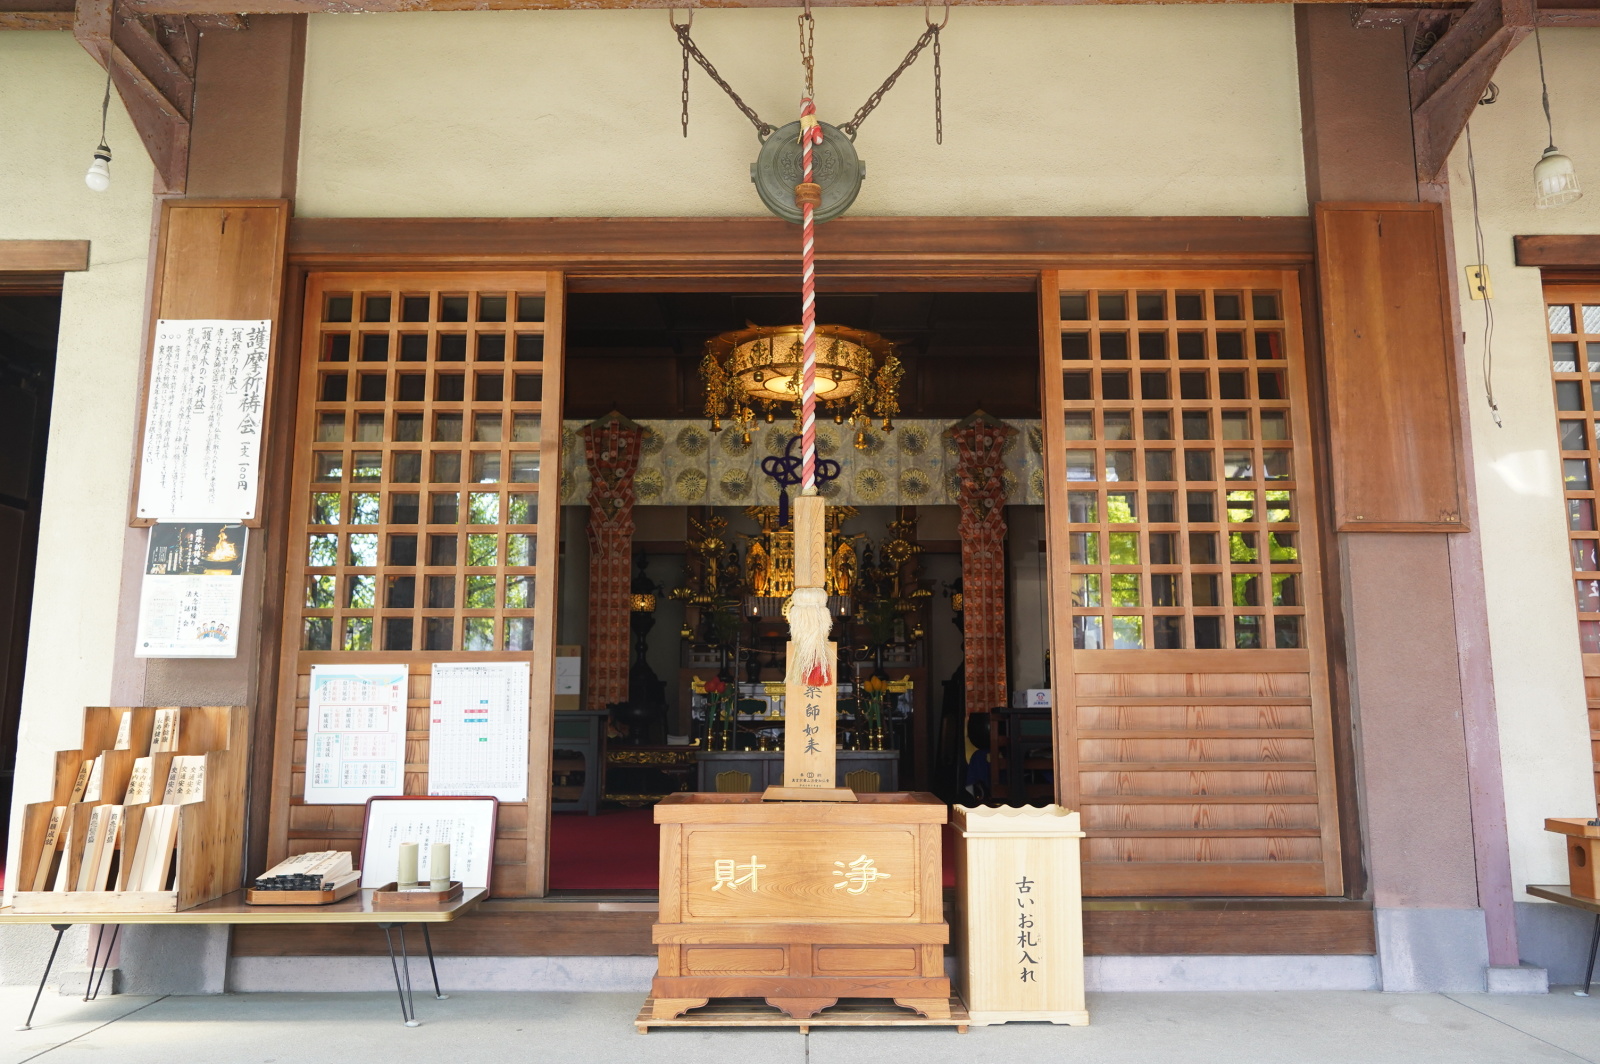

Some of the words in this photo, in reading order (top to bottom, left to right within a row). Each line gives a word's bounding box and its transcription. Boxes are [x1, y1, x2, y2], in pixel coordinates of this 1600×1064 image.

[236, 325, 267, 435] 護摩祈祷会
[176, 766, 188, 794] 交通安全
[1015, 875, 1039, 983] 古いお札入れ
